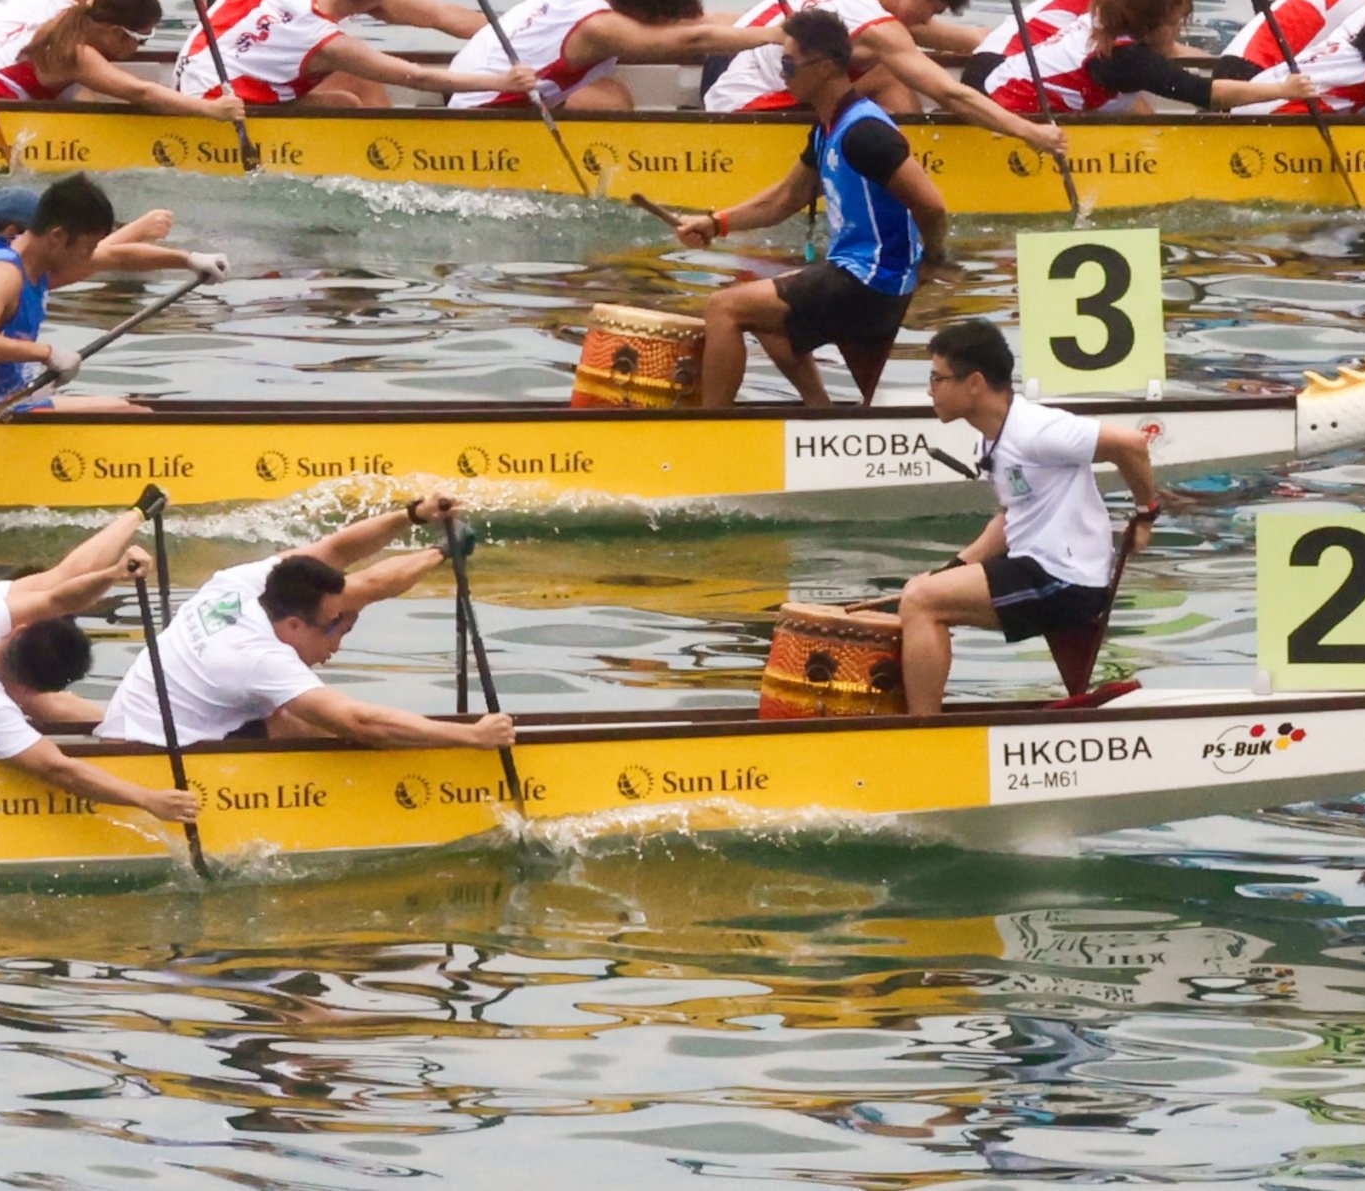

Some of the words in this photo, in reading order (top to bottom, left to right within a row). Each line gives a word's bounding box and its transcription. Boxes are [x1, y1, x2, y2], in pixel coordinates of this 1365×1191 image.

[46, 141, 90, 162] Life
[413, 150, 467, 171] Sun
[473, 150, 520, 172] Life
[628, 152, 678, 171] Sun
[686, 151, 733, 172] Life
[1110, 152, 1156, 173] Life
[1274, 154, 1323, 173] Sun
[1049, 243, 1135, 371] 3
[796, 434, 929, 457] HKCDBA
[94, 458, 141, 477] Sun
[149, 456, 193, 478] Life
[297, 458, 343, 476] Sun
[350, 457, 393, 476] Life
[498, 455, 542, 473] Sun
[551, 452, 593, 473] Life
[866, 462, 931, 477] 24-M51
[1004, 736, 1152, 766] HKCDBA
[1203, 740, 1272, 758] PS-BuK
[662, 772, 716, 793] Sun
[724, 767, 768, 790] Life
[1008, 772, 1078, 790] 24-M61
[217, 788, 269, 811] Sun
[277, 784, 327, 808] Life
[440, 783, 488, 804] Sun
